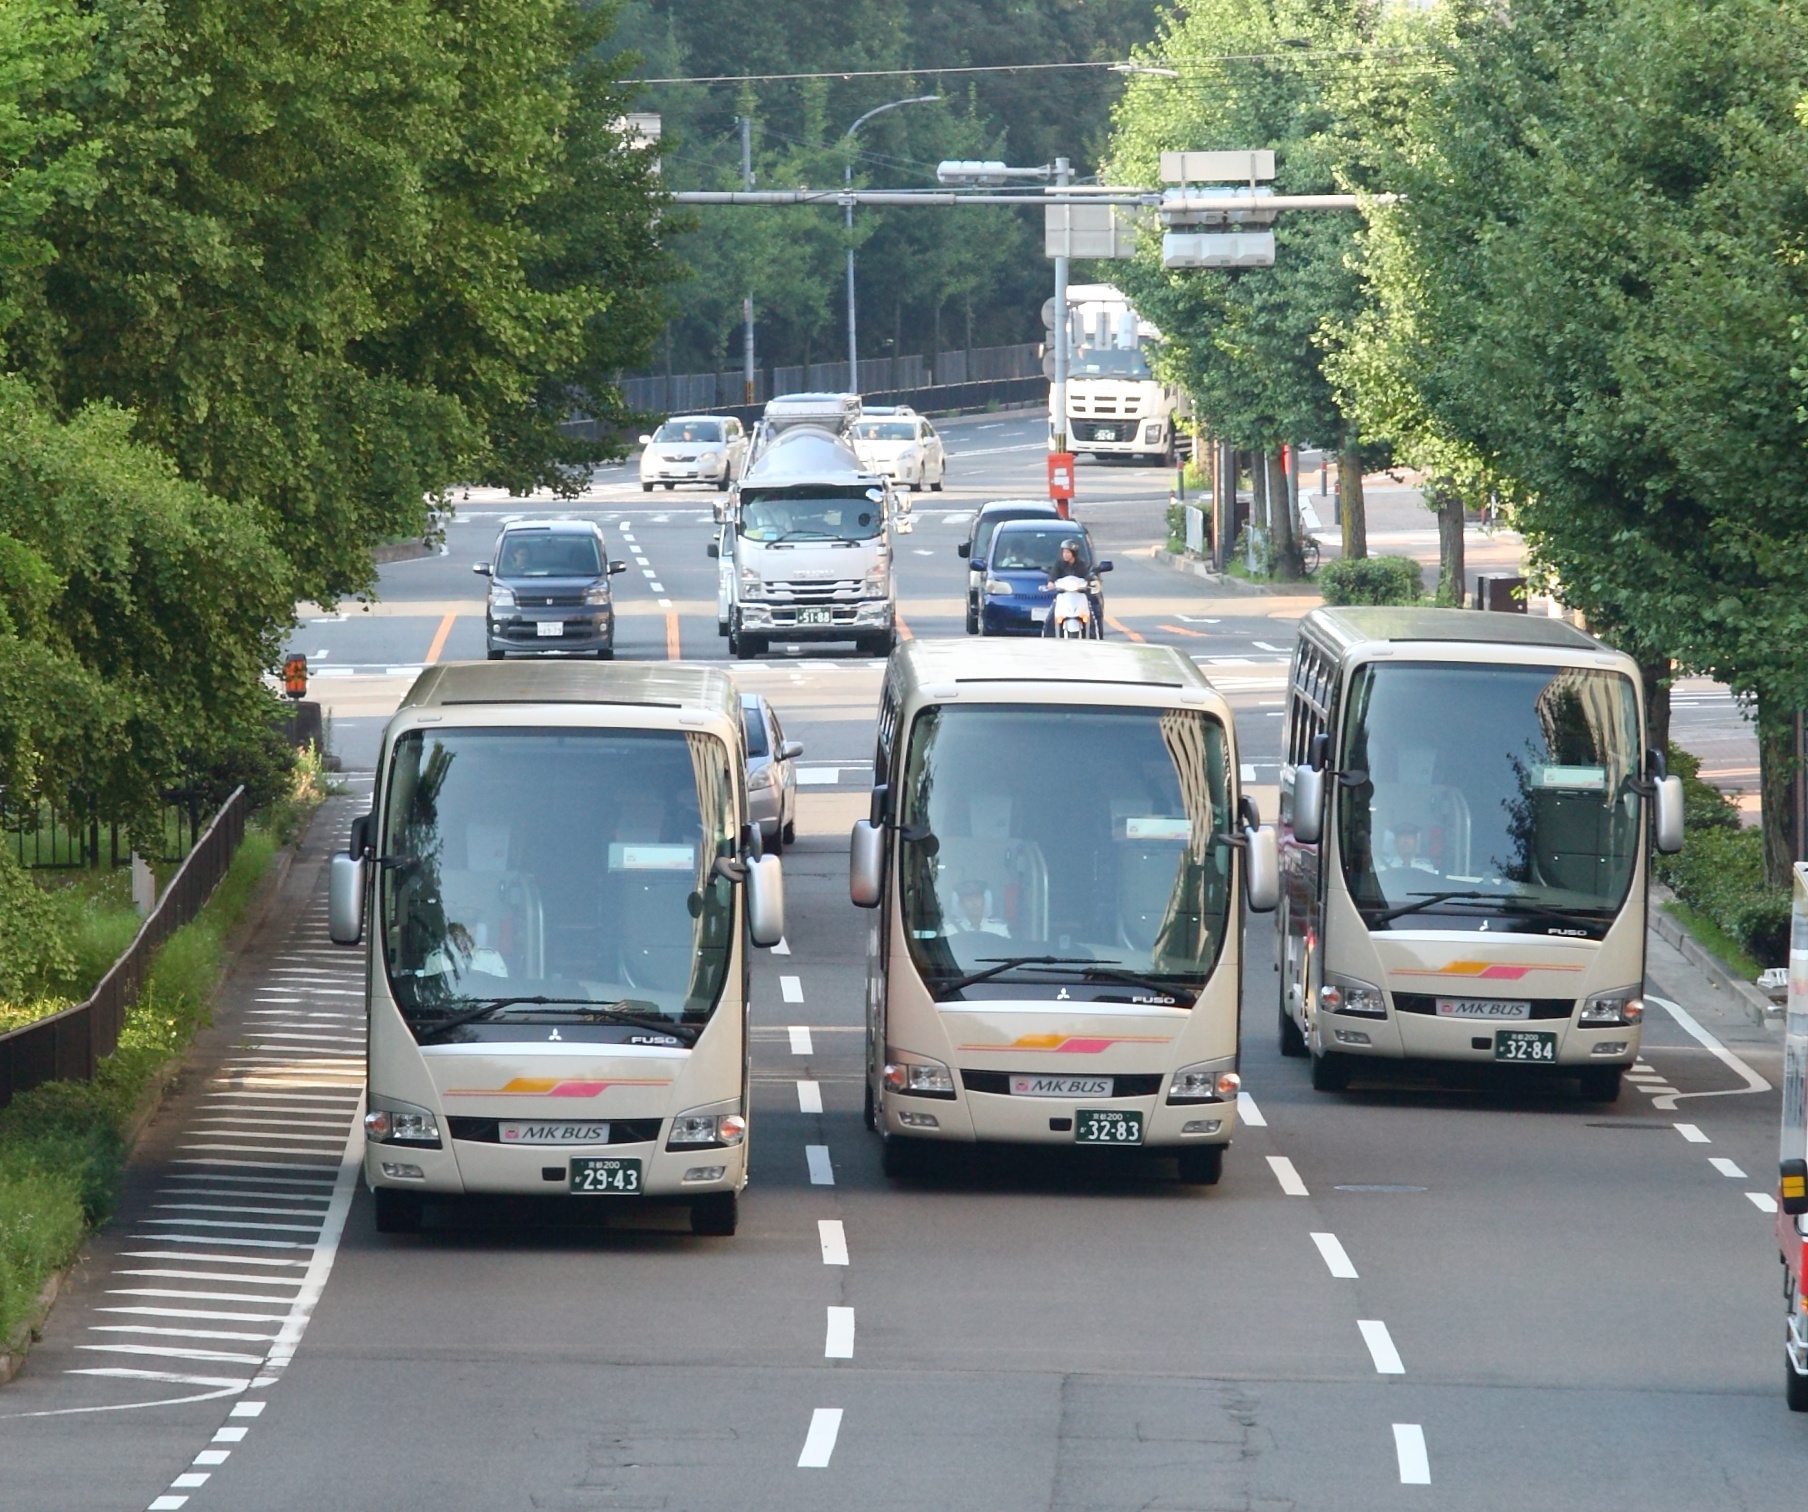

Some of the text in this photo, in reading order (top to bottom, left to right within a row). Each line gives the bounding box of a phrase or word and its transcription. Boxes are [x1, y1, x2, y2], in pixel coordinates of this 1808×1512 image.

[802, 611, 830, 623] 51-88
[1547, 928, 1588, 936] FUSO
[1132, 996, 1176, 1004] FUSO
[1455, 1003, 1525, 1016] MK BUS
[631, 1036, 678, 1044] FUSO
[1506, 1040, 1553, 1060] 32-84
[1031, 1080, 1108, 1093] MK BUS
[522, 1127, 603, 1139] MK BUS
[1088, 1120, 1139, 1140] 32-83
[583, 1169, 638, 1190] 29-43
